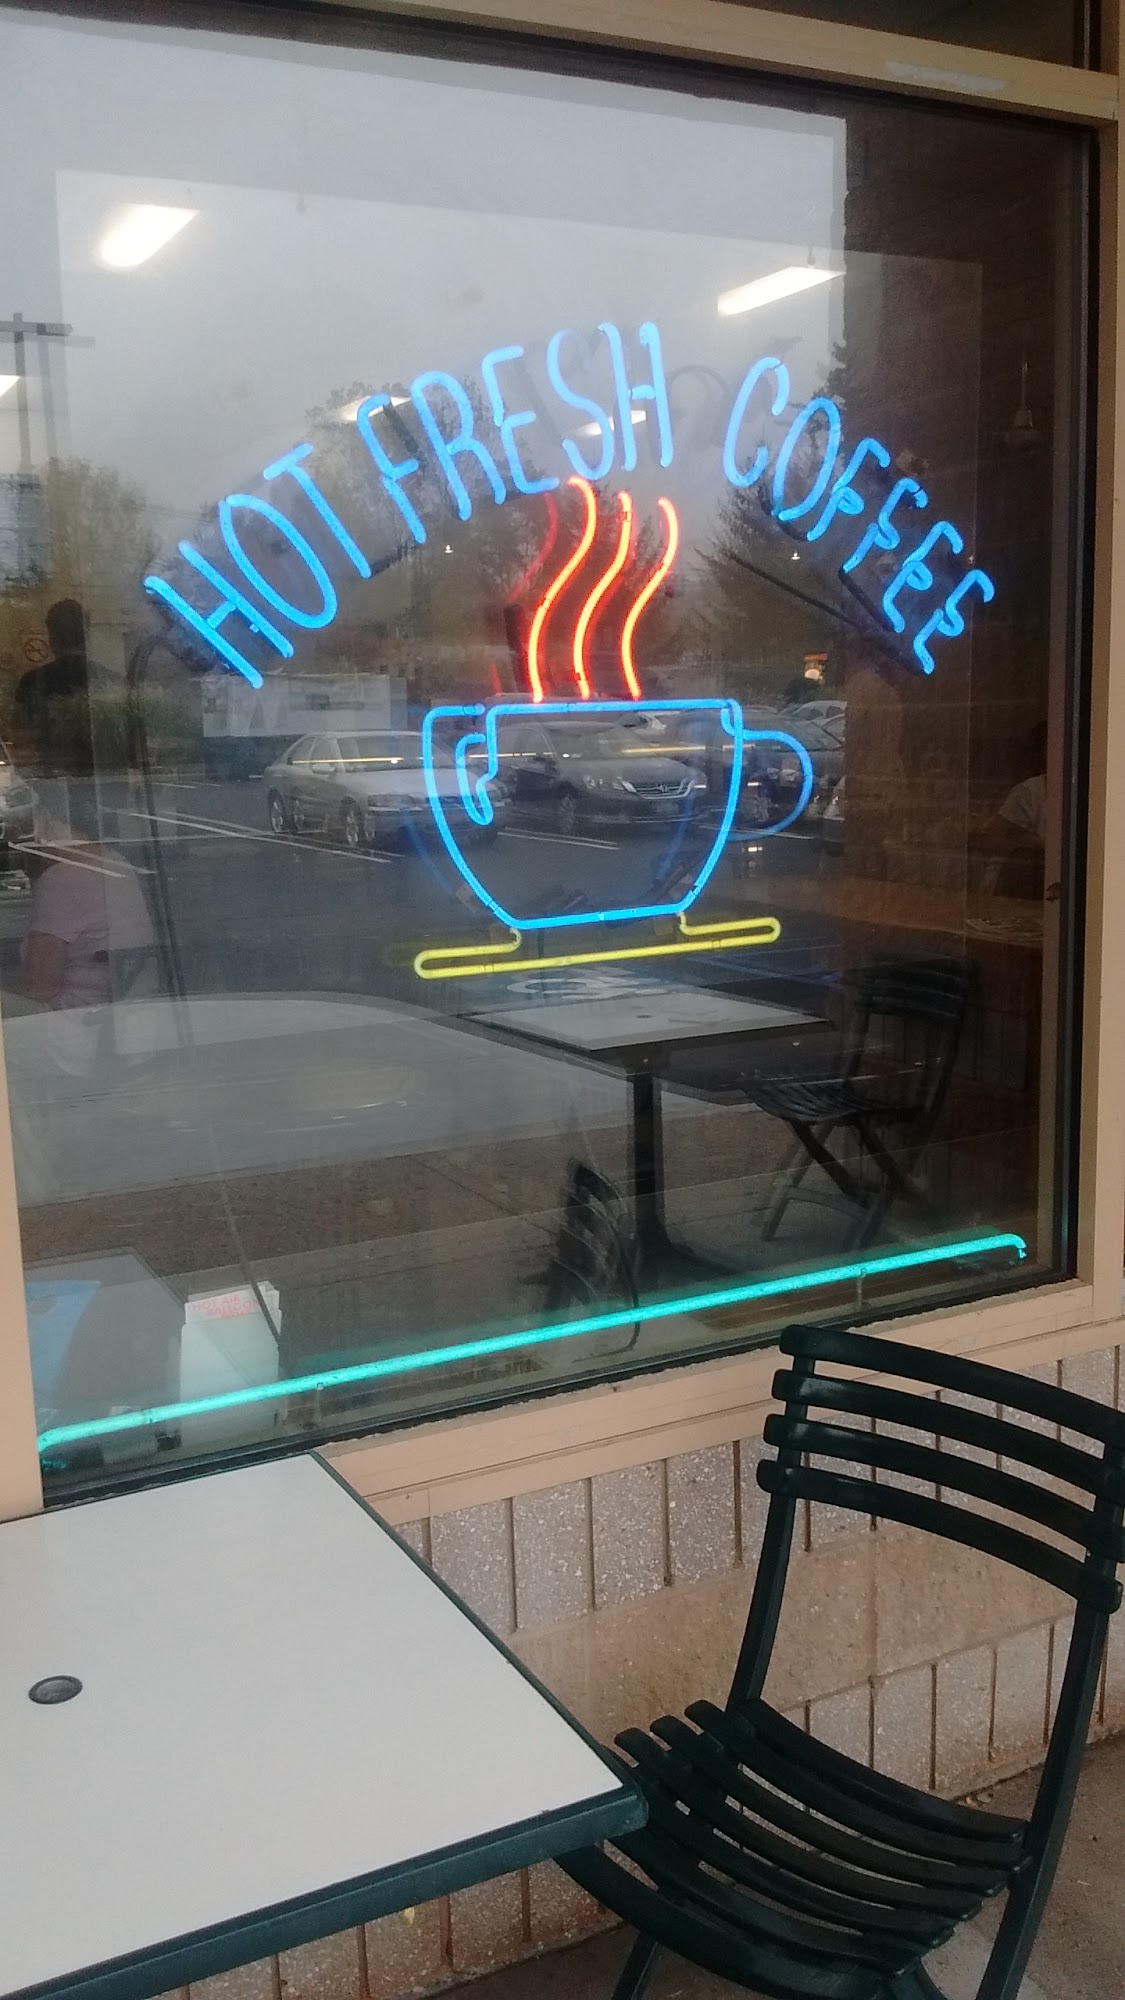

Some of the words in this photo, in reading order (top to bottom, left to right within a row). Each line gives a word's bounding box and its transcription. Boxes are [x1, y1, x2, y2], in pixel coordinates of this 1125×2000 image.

[144, 442, 372, 689] HOT
[357, 321, 673, 545] FRESH
[723, 356, 996, 675] COFFEE
